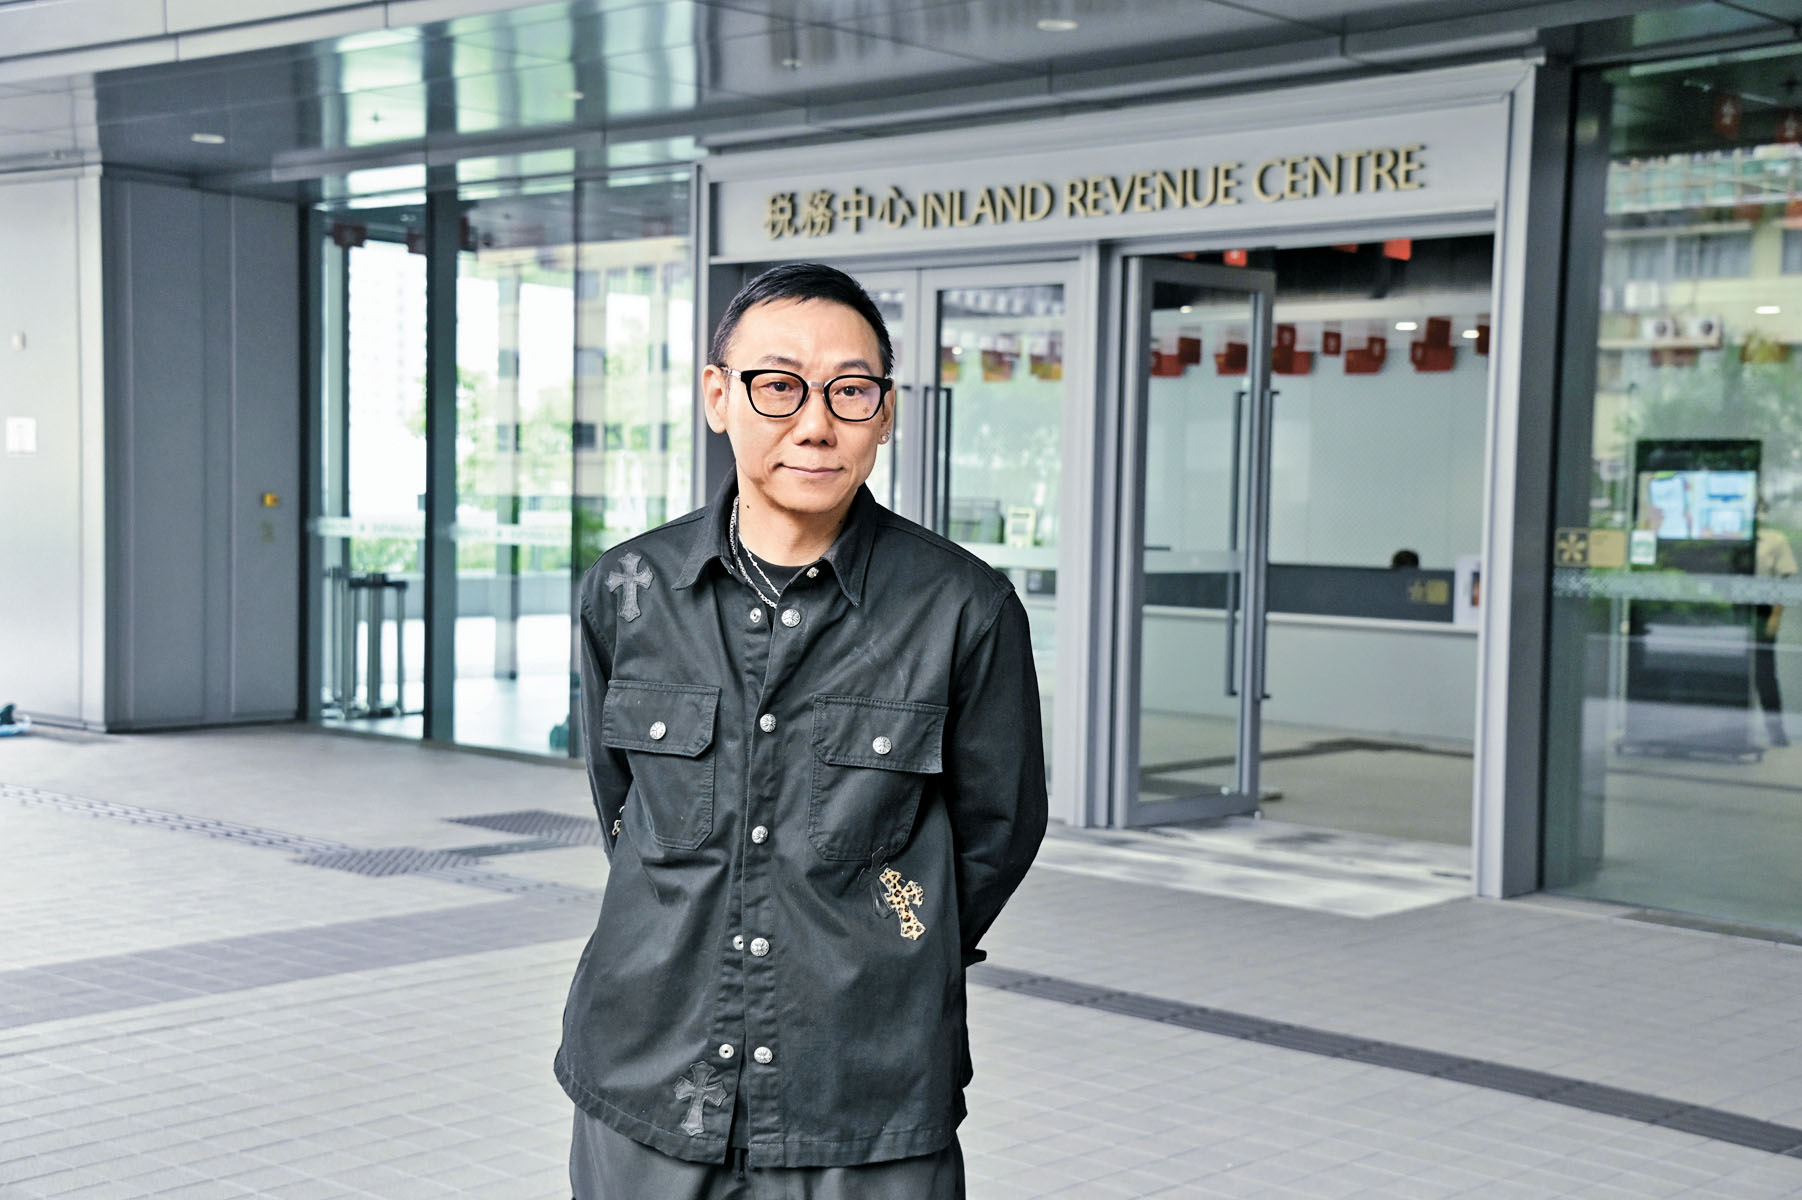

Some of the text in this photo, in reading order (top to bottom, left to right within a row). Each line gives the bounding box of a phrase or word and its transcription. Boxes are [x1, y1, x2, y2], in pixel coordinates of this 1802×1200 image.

[919, 144, 1426, 228] INLAND REVENUE CENTRE
